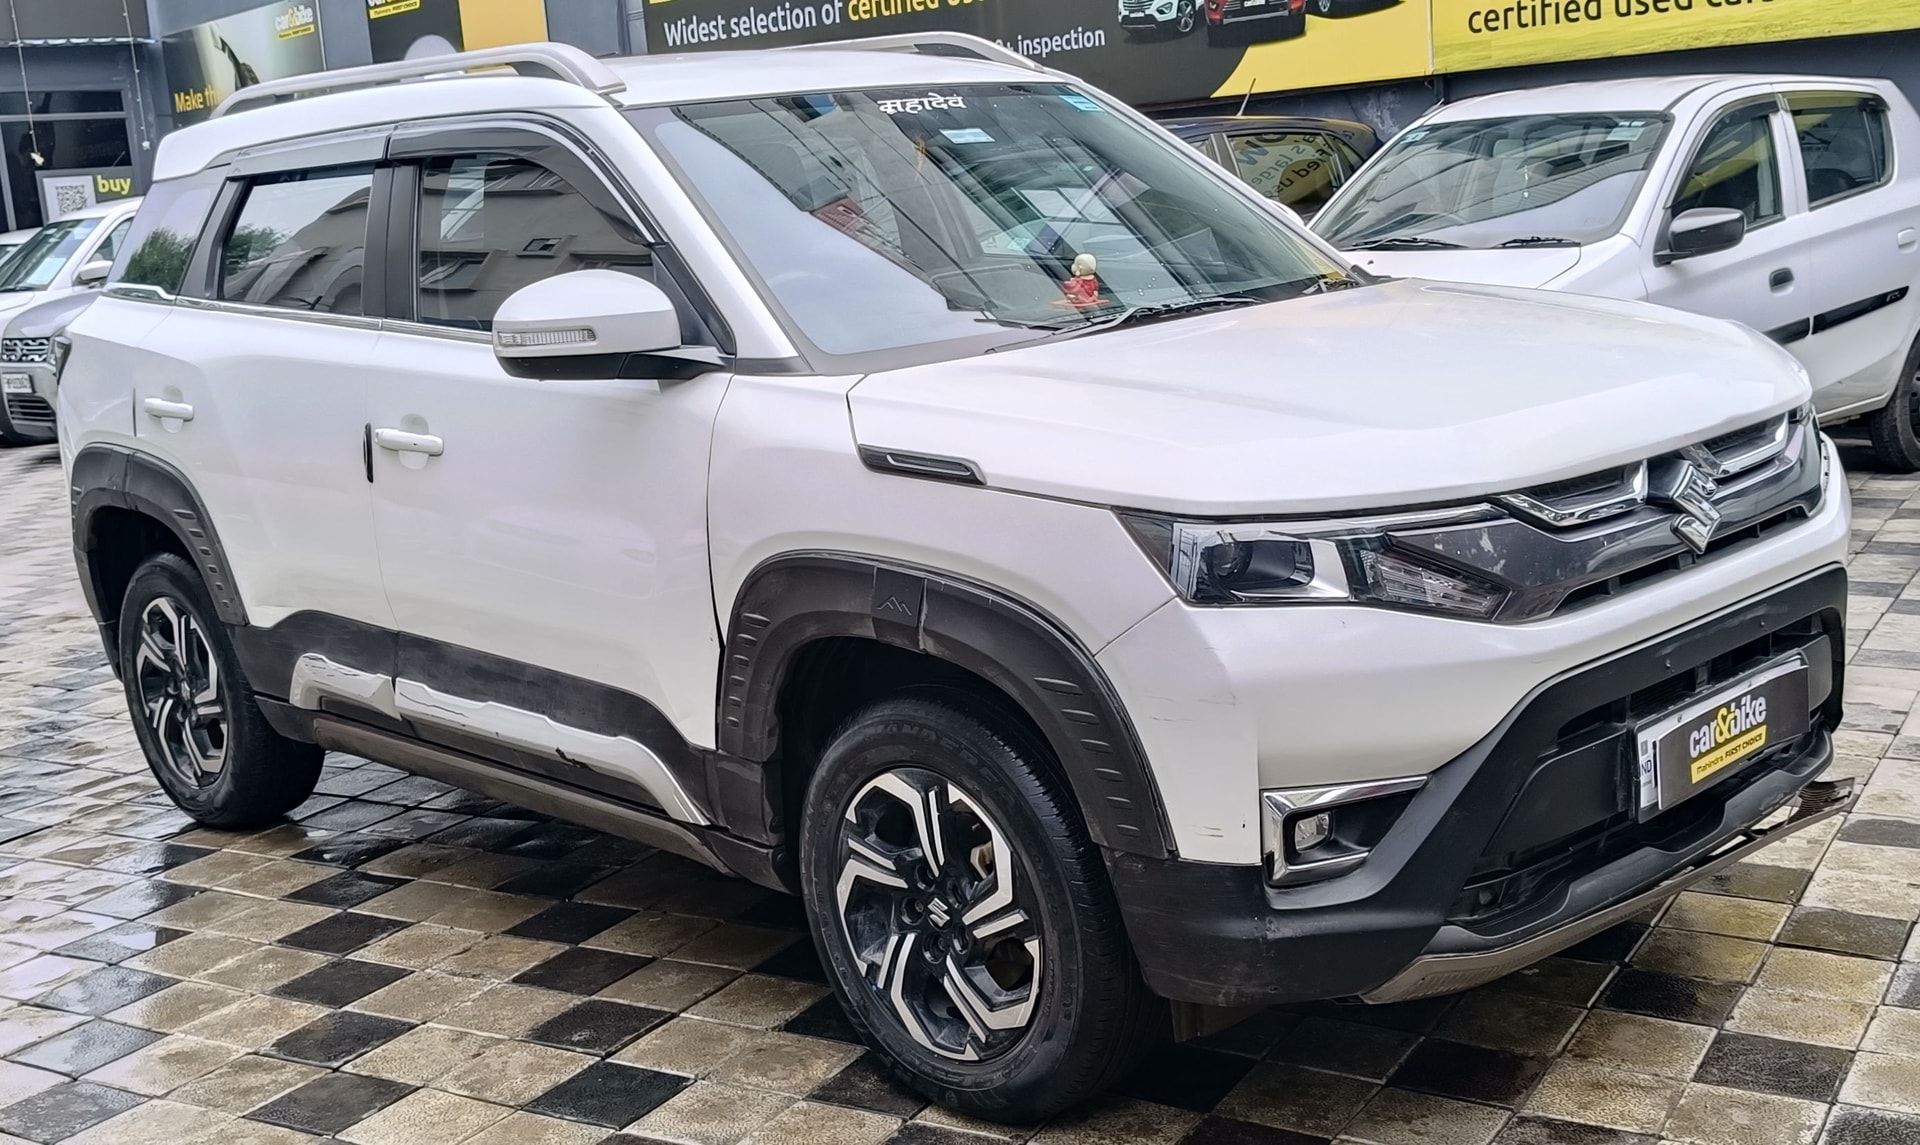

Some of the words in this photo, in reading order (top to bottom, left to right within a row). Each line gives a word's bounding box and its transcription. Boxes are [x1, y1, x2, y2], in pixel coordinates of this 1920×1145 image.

[663, 15, 727, 47] Widest
[730, 2, 817, 39] selection
[821, 0, 843, 25] of
[1017, 26, 1106, 58] inspection
[174, 88, 204, 113] Make
[96, 174, 132, 195] buy
[1689, 694, 1767, 758] car&bike
